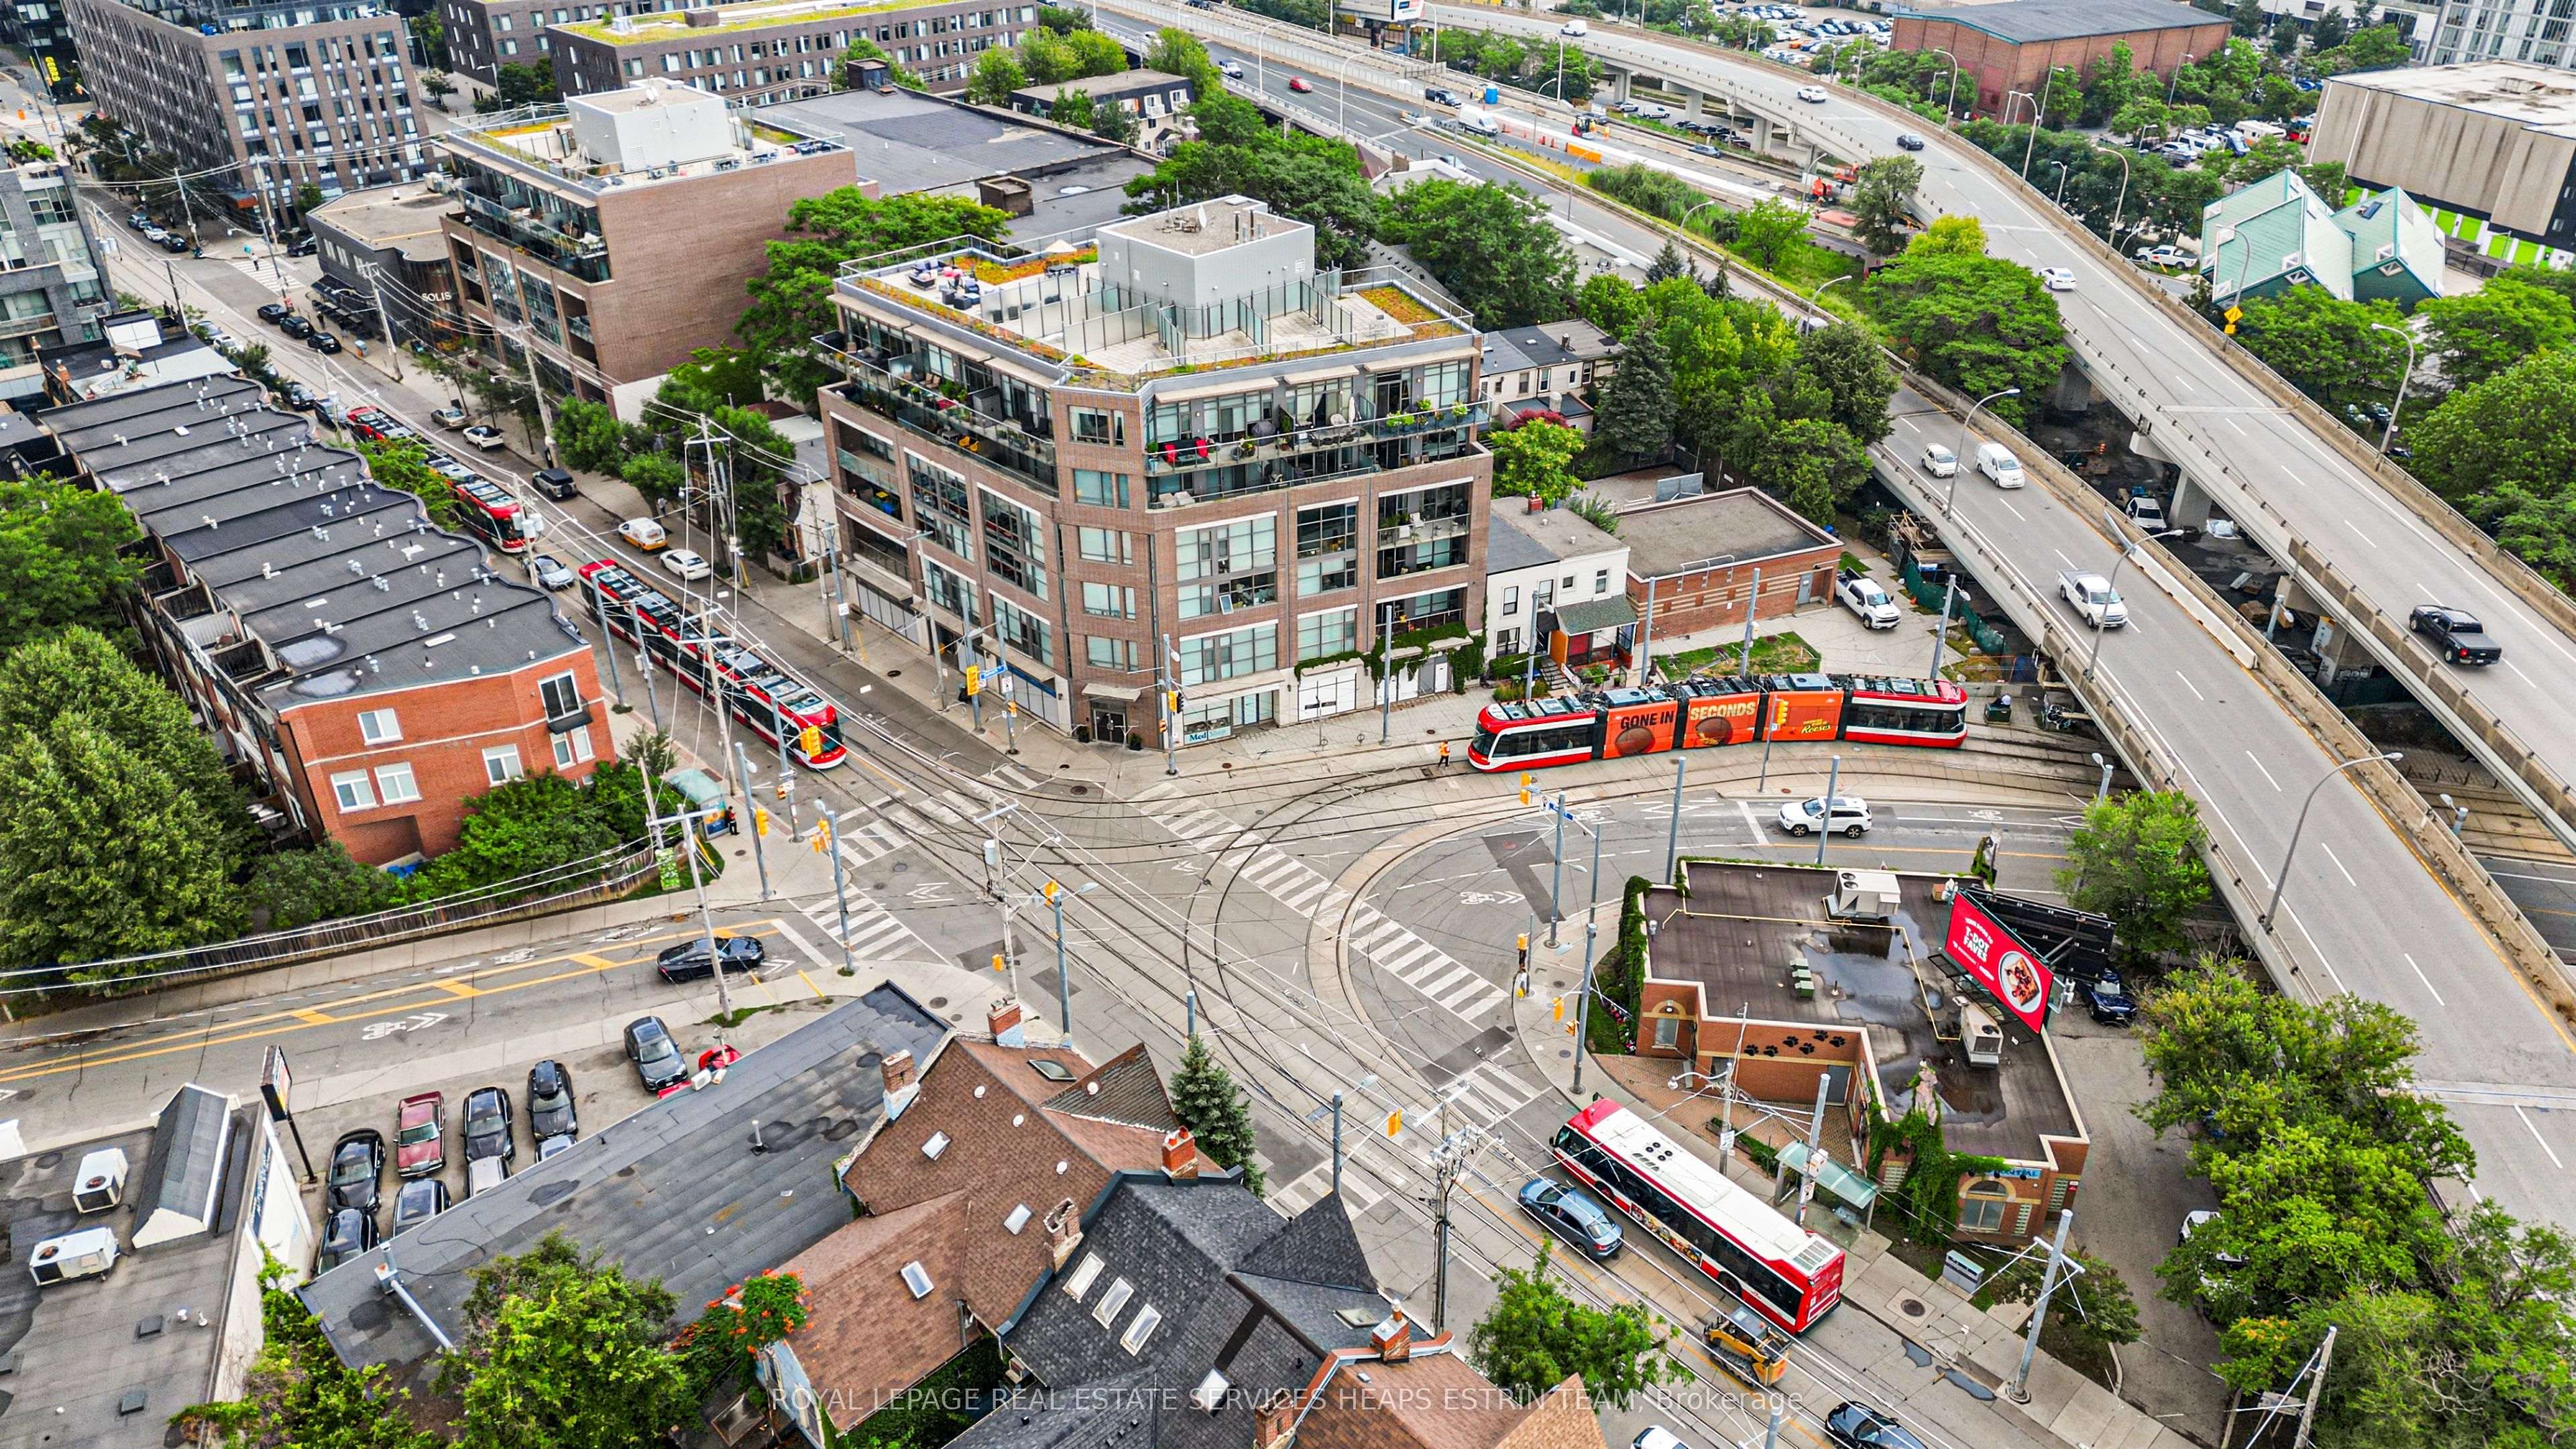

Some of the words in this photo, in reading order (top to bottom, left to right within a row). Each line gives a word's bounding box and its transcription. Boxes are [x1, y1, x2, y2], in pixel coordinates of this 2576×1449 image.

[45, 56, 60, 81] GEARS
[421, 291, 452, 302] SOLIS
[1621, 712, 1658, 729] GONE
[1660, 710, 1674, 723] IN
[1690, 702, 1756, 720] SECONDS
[1189, 731, 1206, 741] Med
[1964, 935, 1988, 963] FAVES
[1966, 926, 1990, 953] T-DOT
